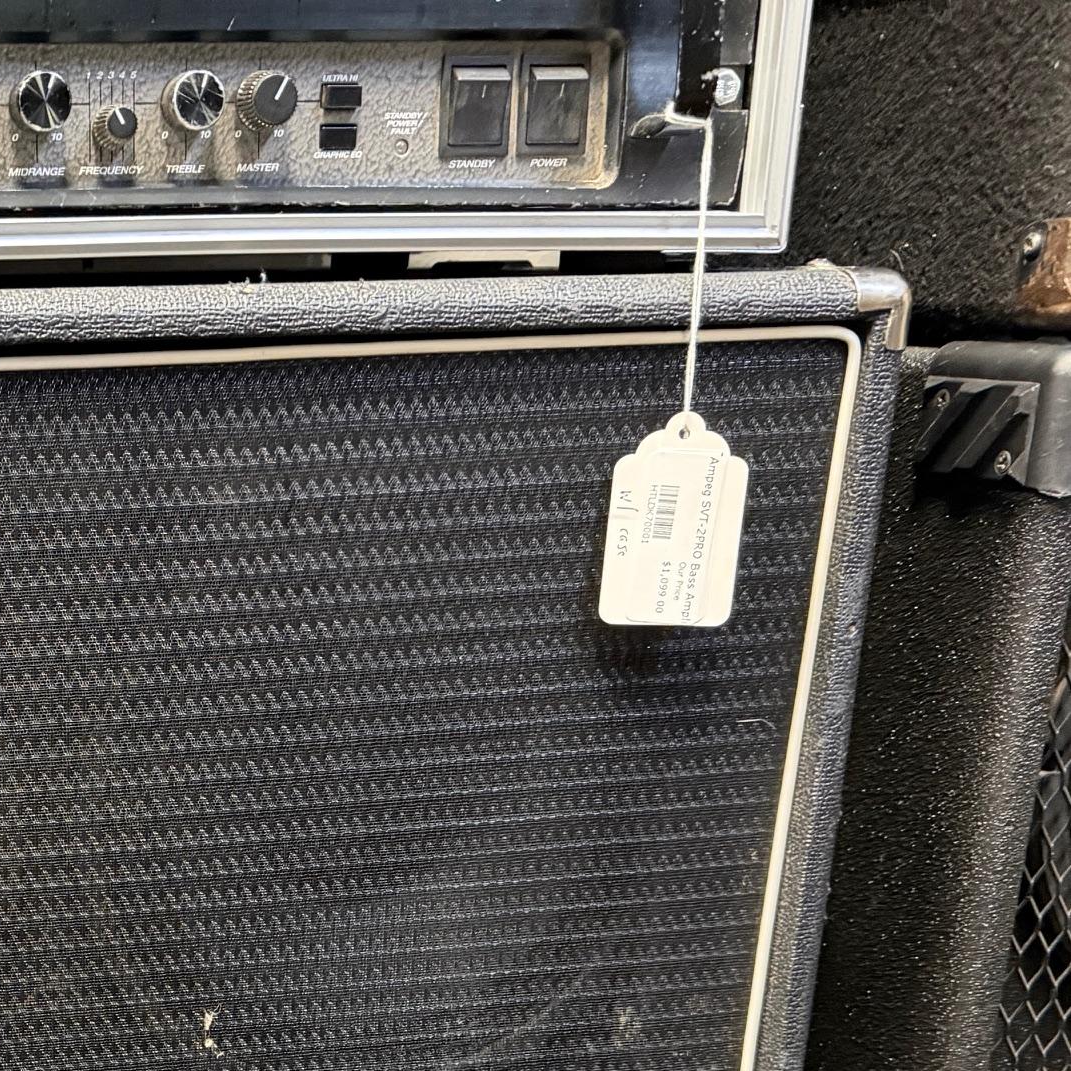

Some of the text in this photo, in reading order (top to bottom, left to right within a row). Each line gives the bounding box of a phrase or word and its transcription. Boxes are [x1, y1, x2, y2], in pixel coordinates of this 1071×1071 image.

[97, 72, 104, 80] 2
[107, 71, 115, 80] 3
[118, 71, 126, 79] 4
[130, 71, 138, 79] 5
[322, 74, 359, 82] ULTRA HI
[11, 133, 19, 142] 0
[51, 132, 63, 141] 10
[161, 131, 169, 140] 0
[200, 130, 212, 139] 10
[235, 130, 242, 138] 0
[274, 129, 285, 138] 10
[314, 151, 350, 159] GRAPHIC
[236, 163, 280, 173] MASTER
[448, 159, 496, 169] STANDBY
[530, 158, 569, 168] POWER
[8, 167, 66, 177] MIDRANGE
[79, 165, 145, 176] FREQUENCY
[166, 164, 206, 174] TREBLE
[702, 456, 719, 495] Ampeg
[692, 500, 712, 559] SVT-2PRO
[687, 563, 701, 589] Bass
[673, 562, 687, 601] Our Price
